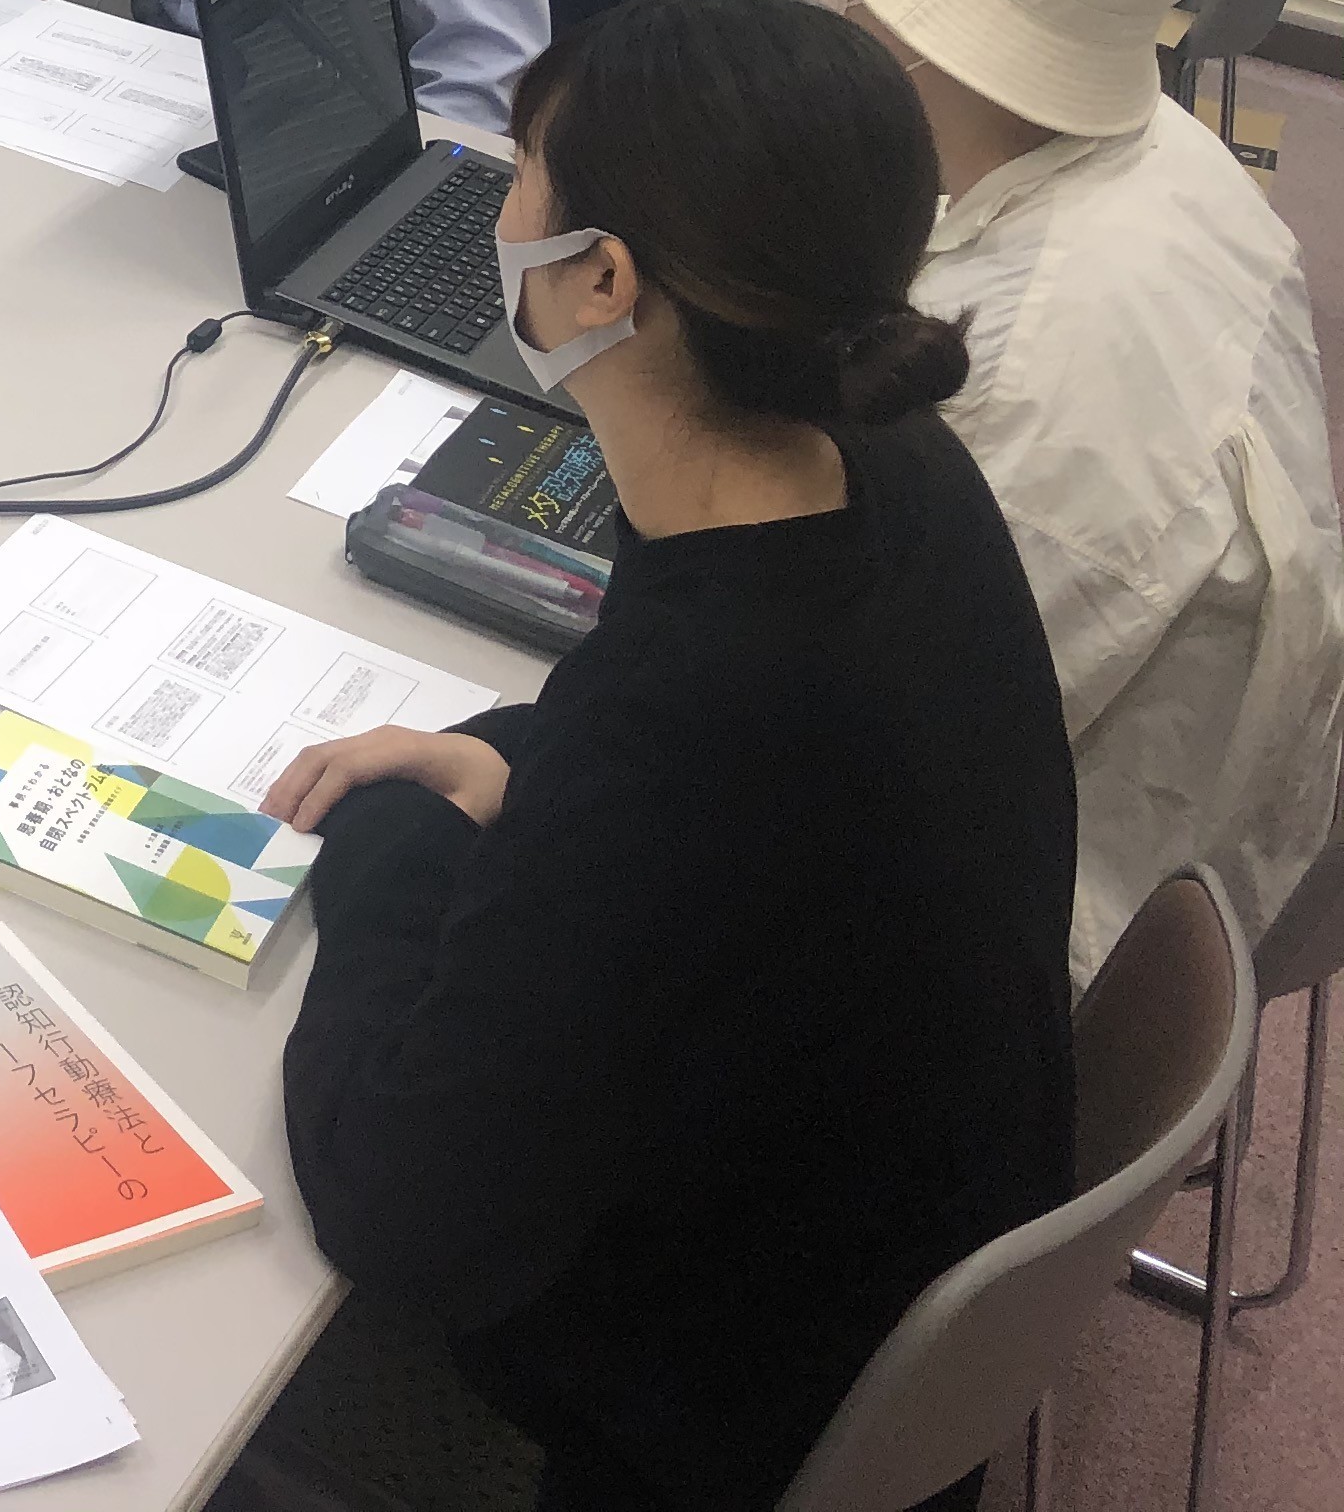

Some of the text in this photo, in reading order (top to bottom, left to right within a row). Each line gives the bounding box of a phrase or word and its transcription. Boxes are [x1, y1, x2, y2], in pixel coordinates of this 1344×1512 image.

[489, 425, 564, 511] METACOGNITIVE THERAPY
[8, 761, 49, 809] 事例でわかる
[17, 756, 86, 838] 思春期・おとなの
[38, 763, 115, 854] 自閉スペクトラム症
